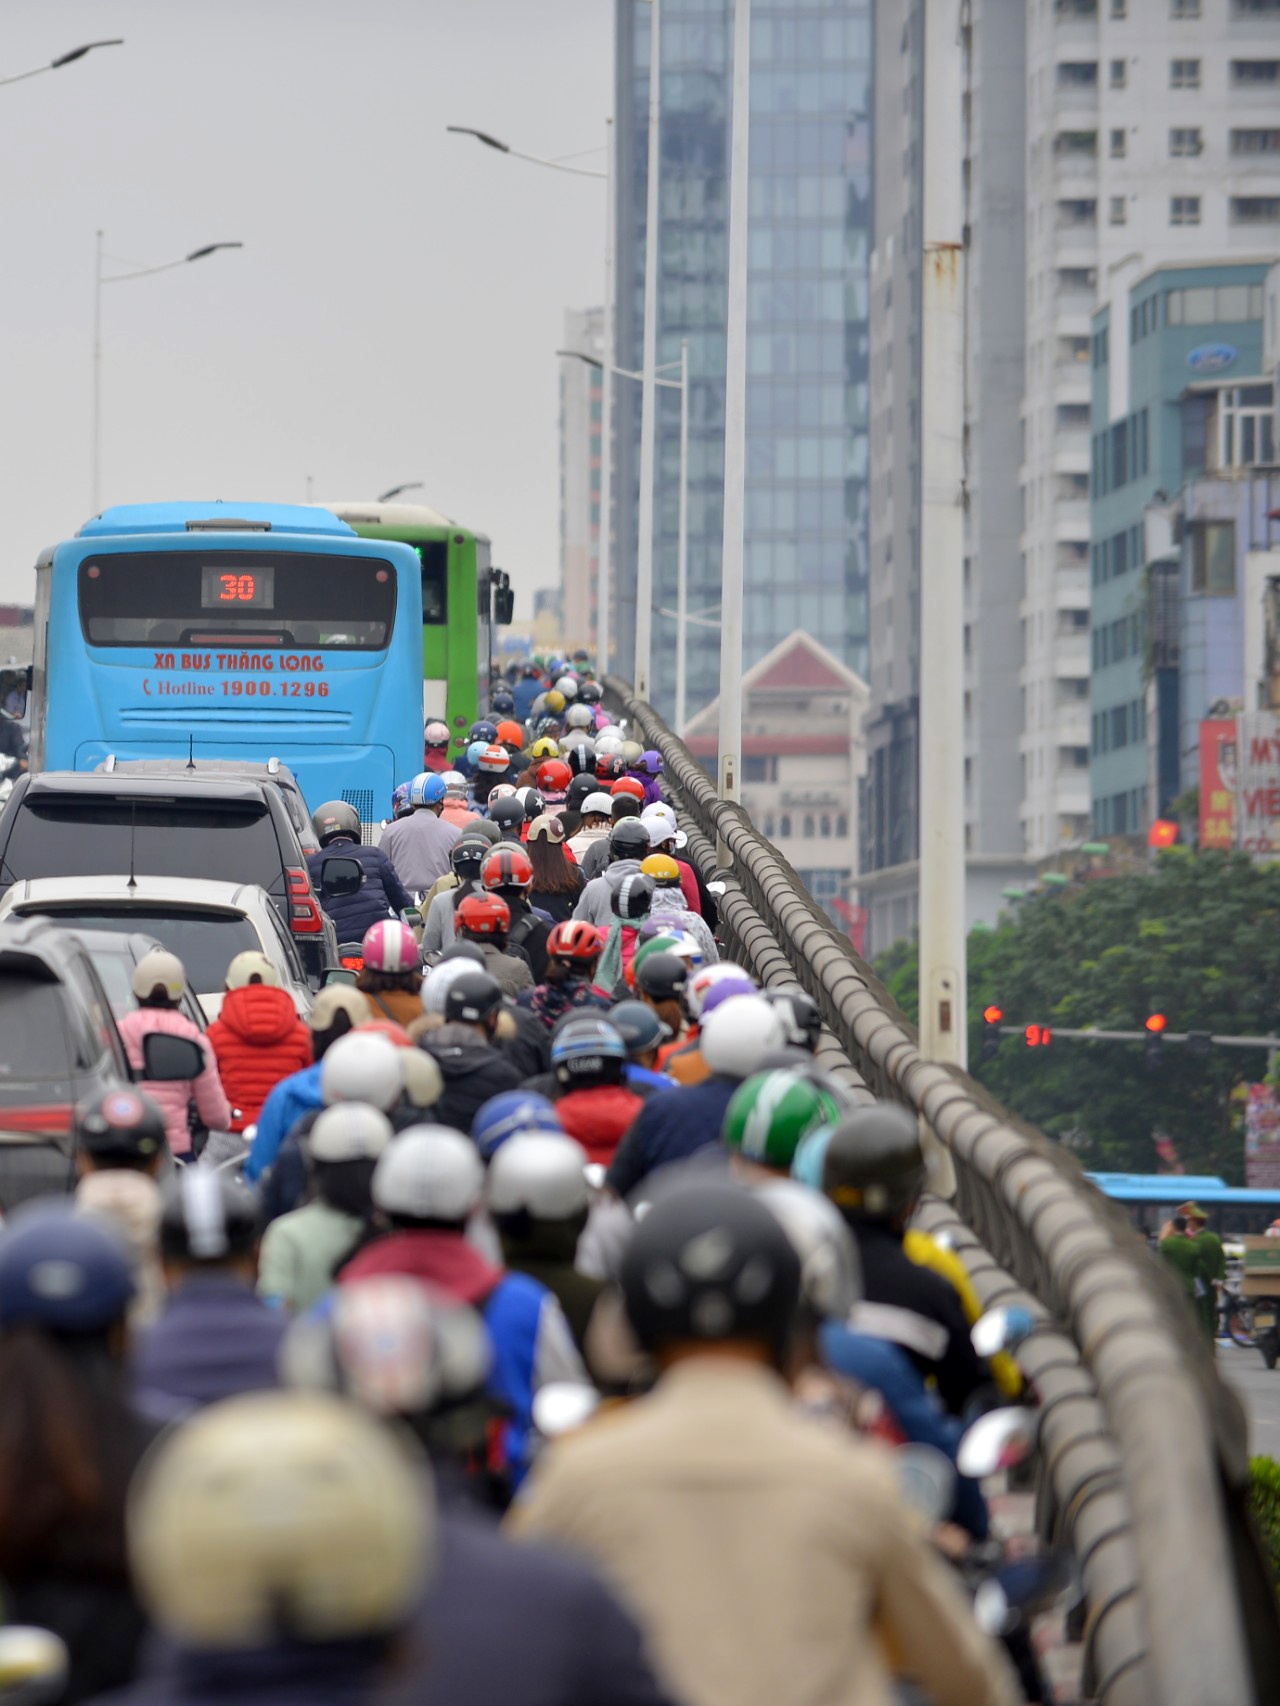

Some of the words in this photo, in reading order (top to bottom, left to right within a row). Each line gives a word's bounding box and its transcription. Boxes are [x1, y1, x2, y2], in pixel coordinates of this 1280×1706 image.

[220, 574, 256, 600] 30
[181, 653, 212, 669] BUS
[216, 651, 274, 670] THĂNG
[279, 654, 324, 671] LONG
[157, 680, 215, 695] Hotline
[220, 680, 329, 697] 1900.1296
[1025, 1025, 1051, 1047] 91
